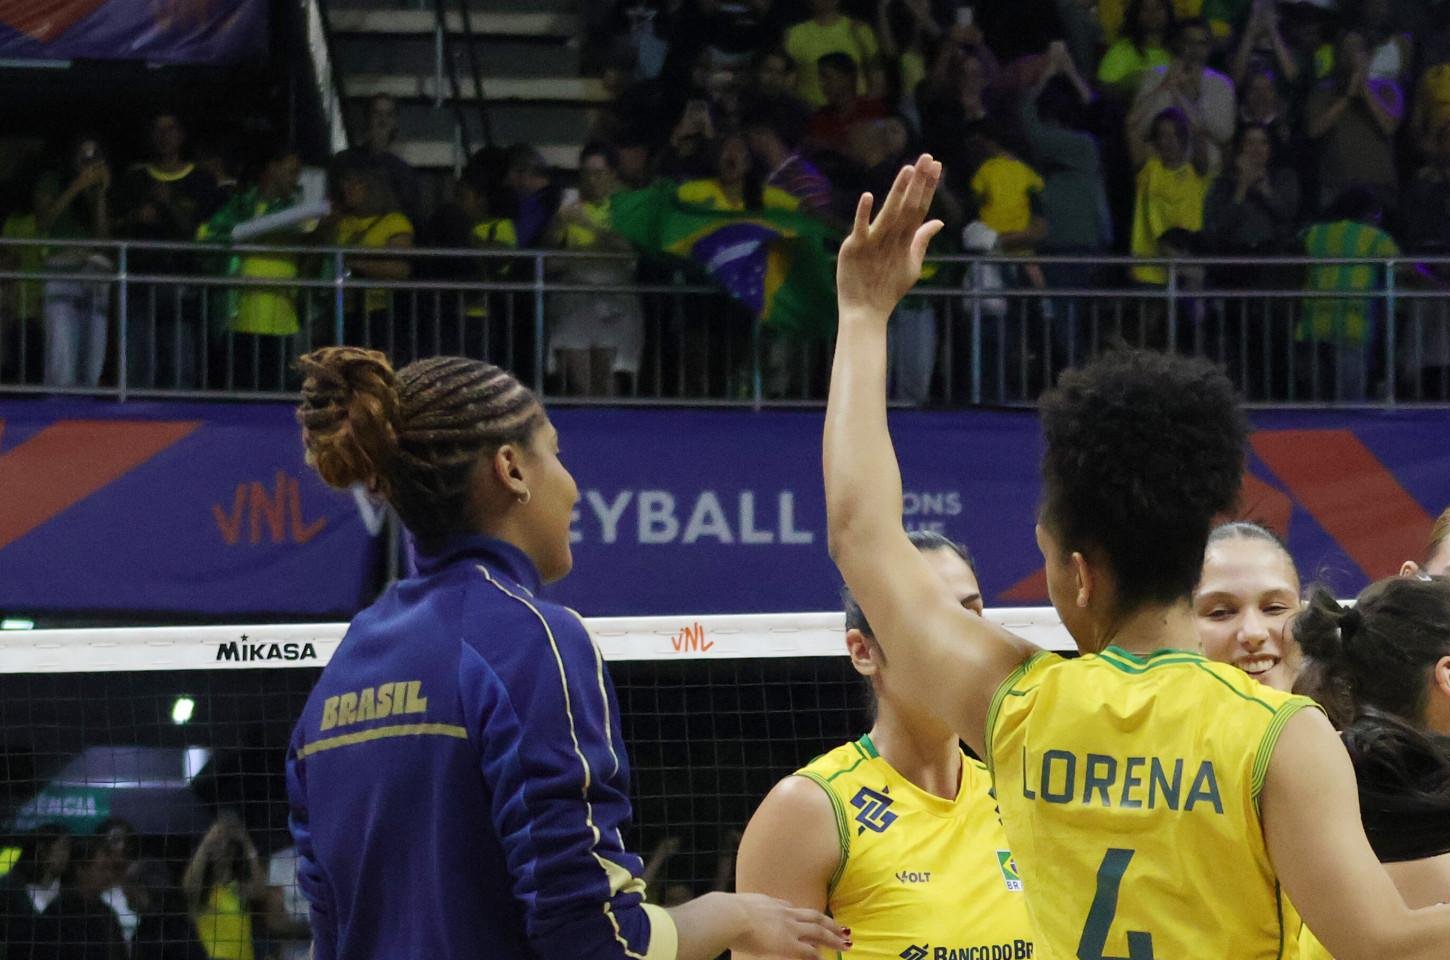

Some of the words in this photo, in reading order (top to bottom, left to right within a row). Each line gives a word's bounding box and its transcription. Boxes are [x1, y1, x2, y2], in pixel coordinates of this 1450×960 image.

[216, 634, 317, 662] MIKASA
[671, 622, 714, 653] VNL
[320, 680, 428, 732] BRASIL
[1023, 745, 1223, 815] LORENA
